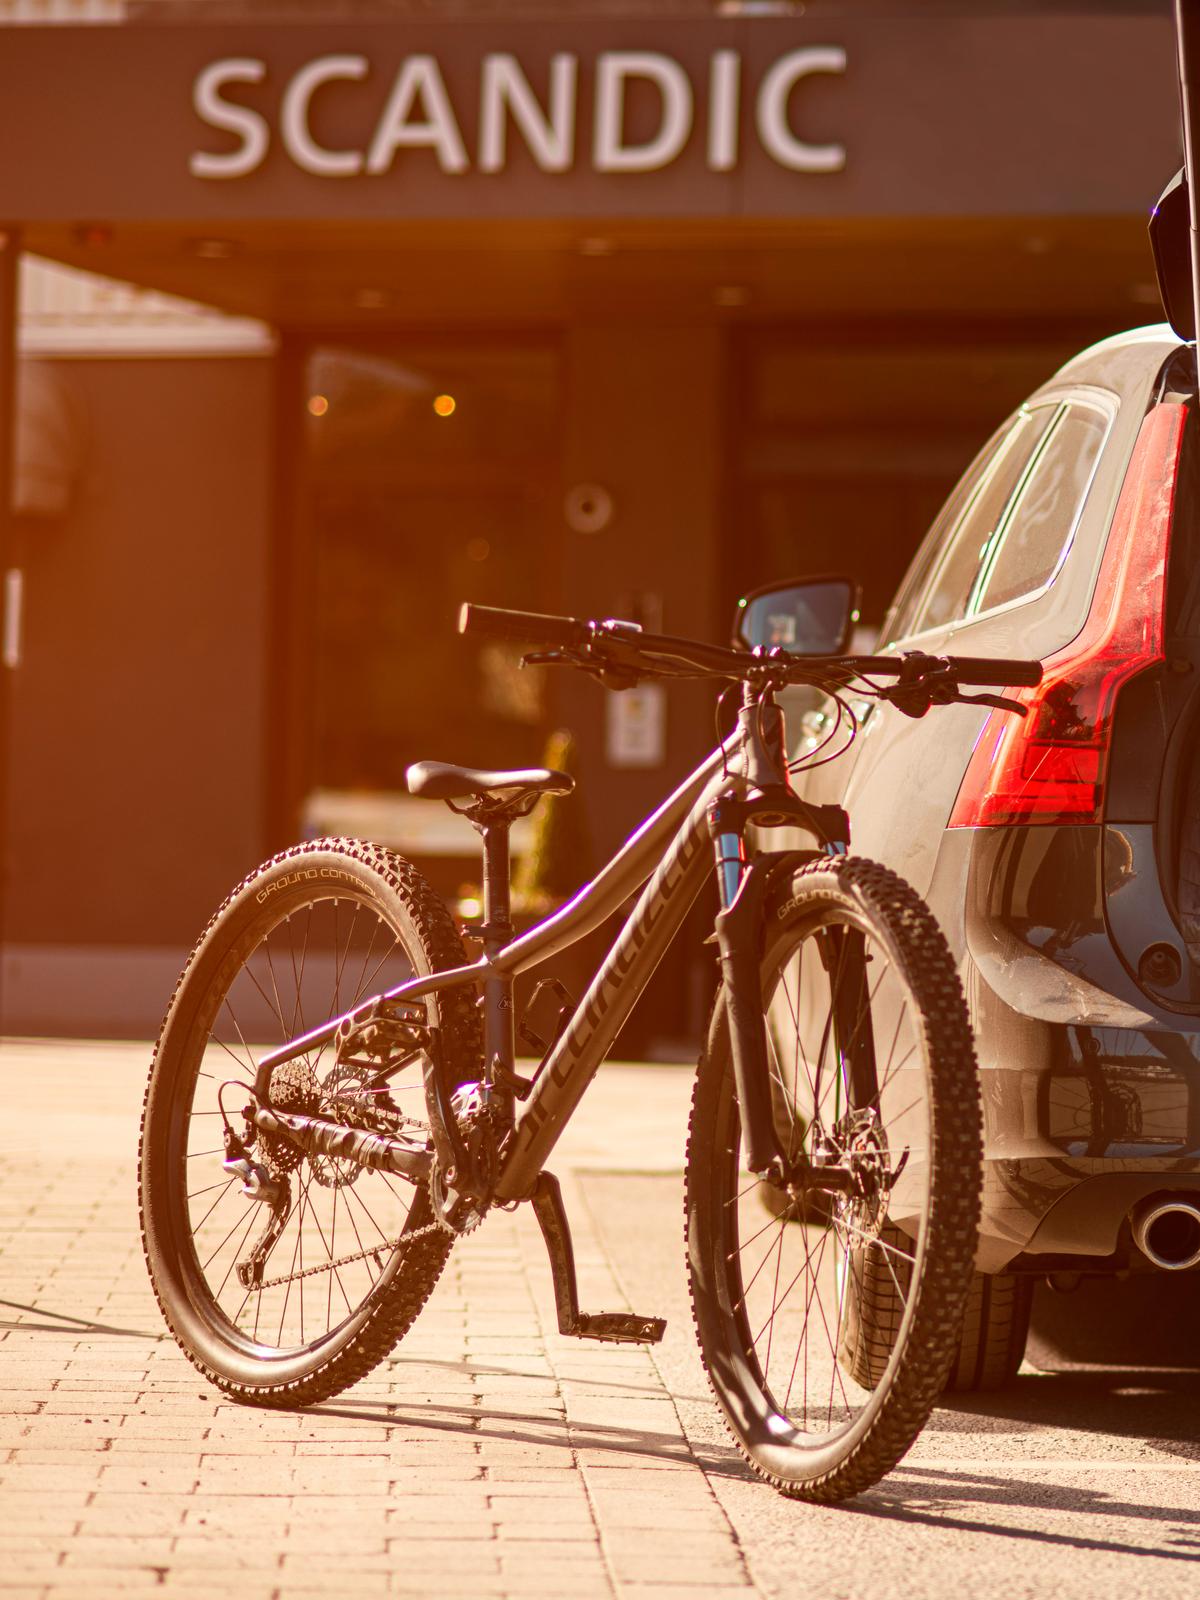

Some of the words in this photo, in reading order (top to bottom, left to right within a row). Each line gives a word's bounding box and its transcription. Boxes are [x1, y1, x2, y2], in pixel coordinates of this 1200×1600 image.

[189, 46, 847, 179] SCANDIC
[255, 868, 318, 905] GROUND
[777, 888, 831, 919] GROUND
